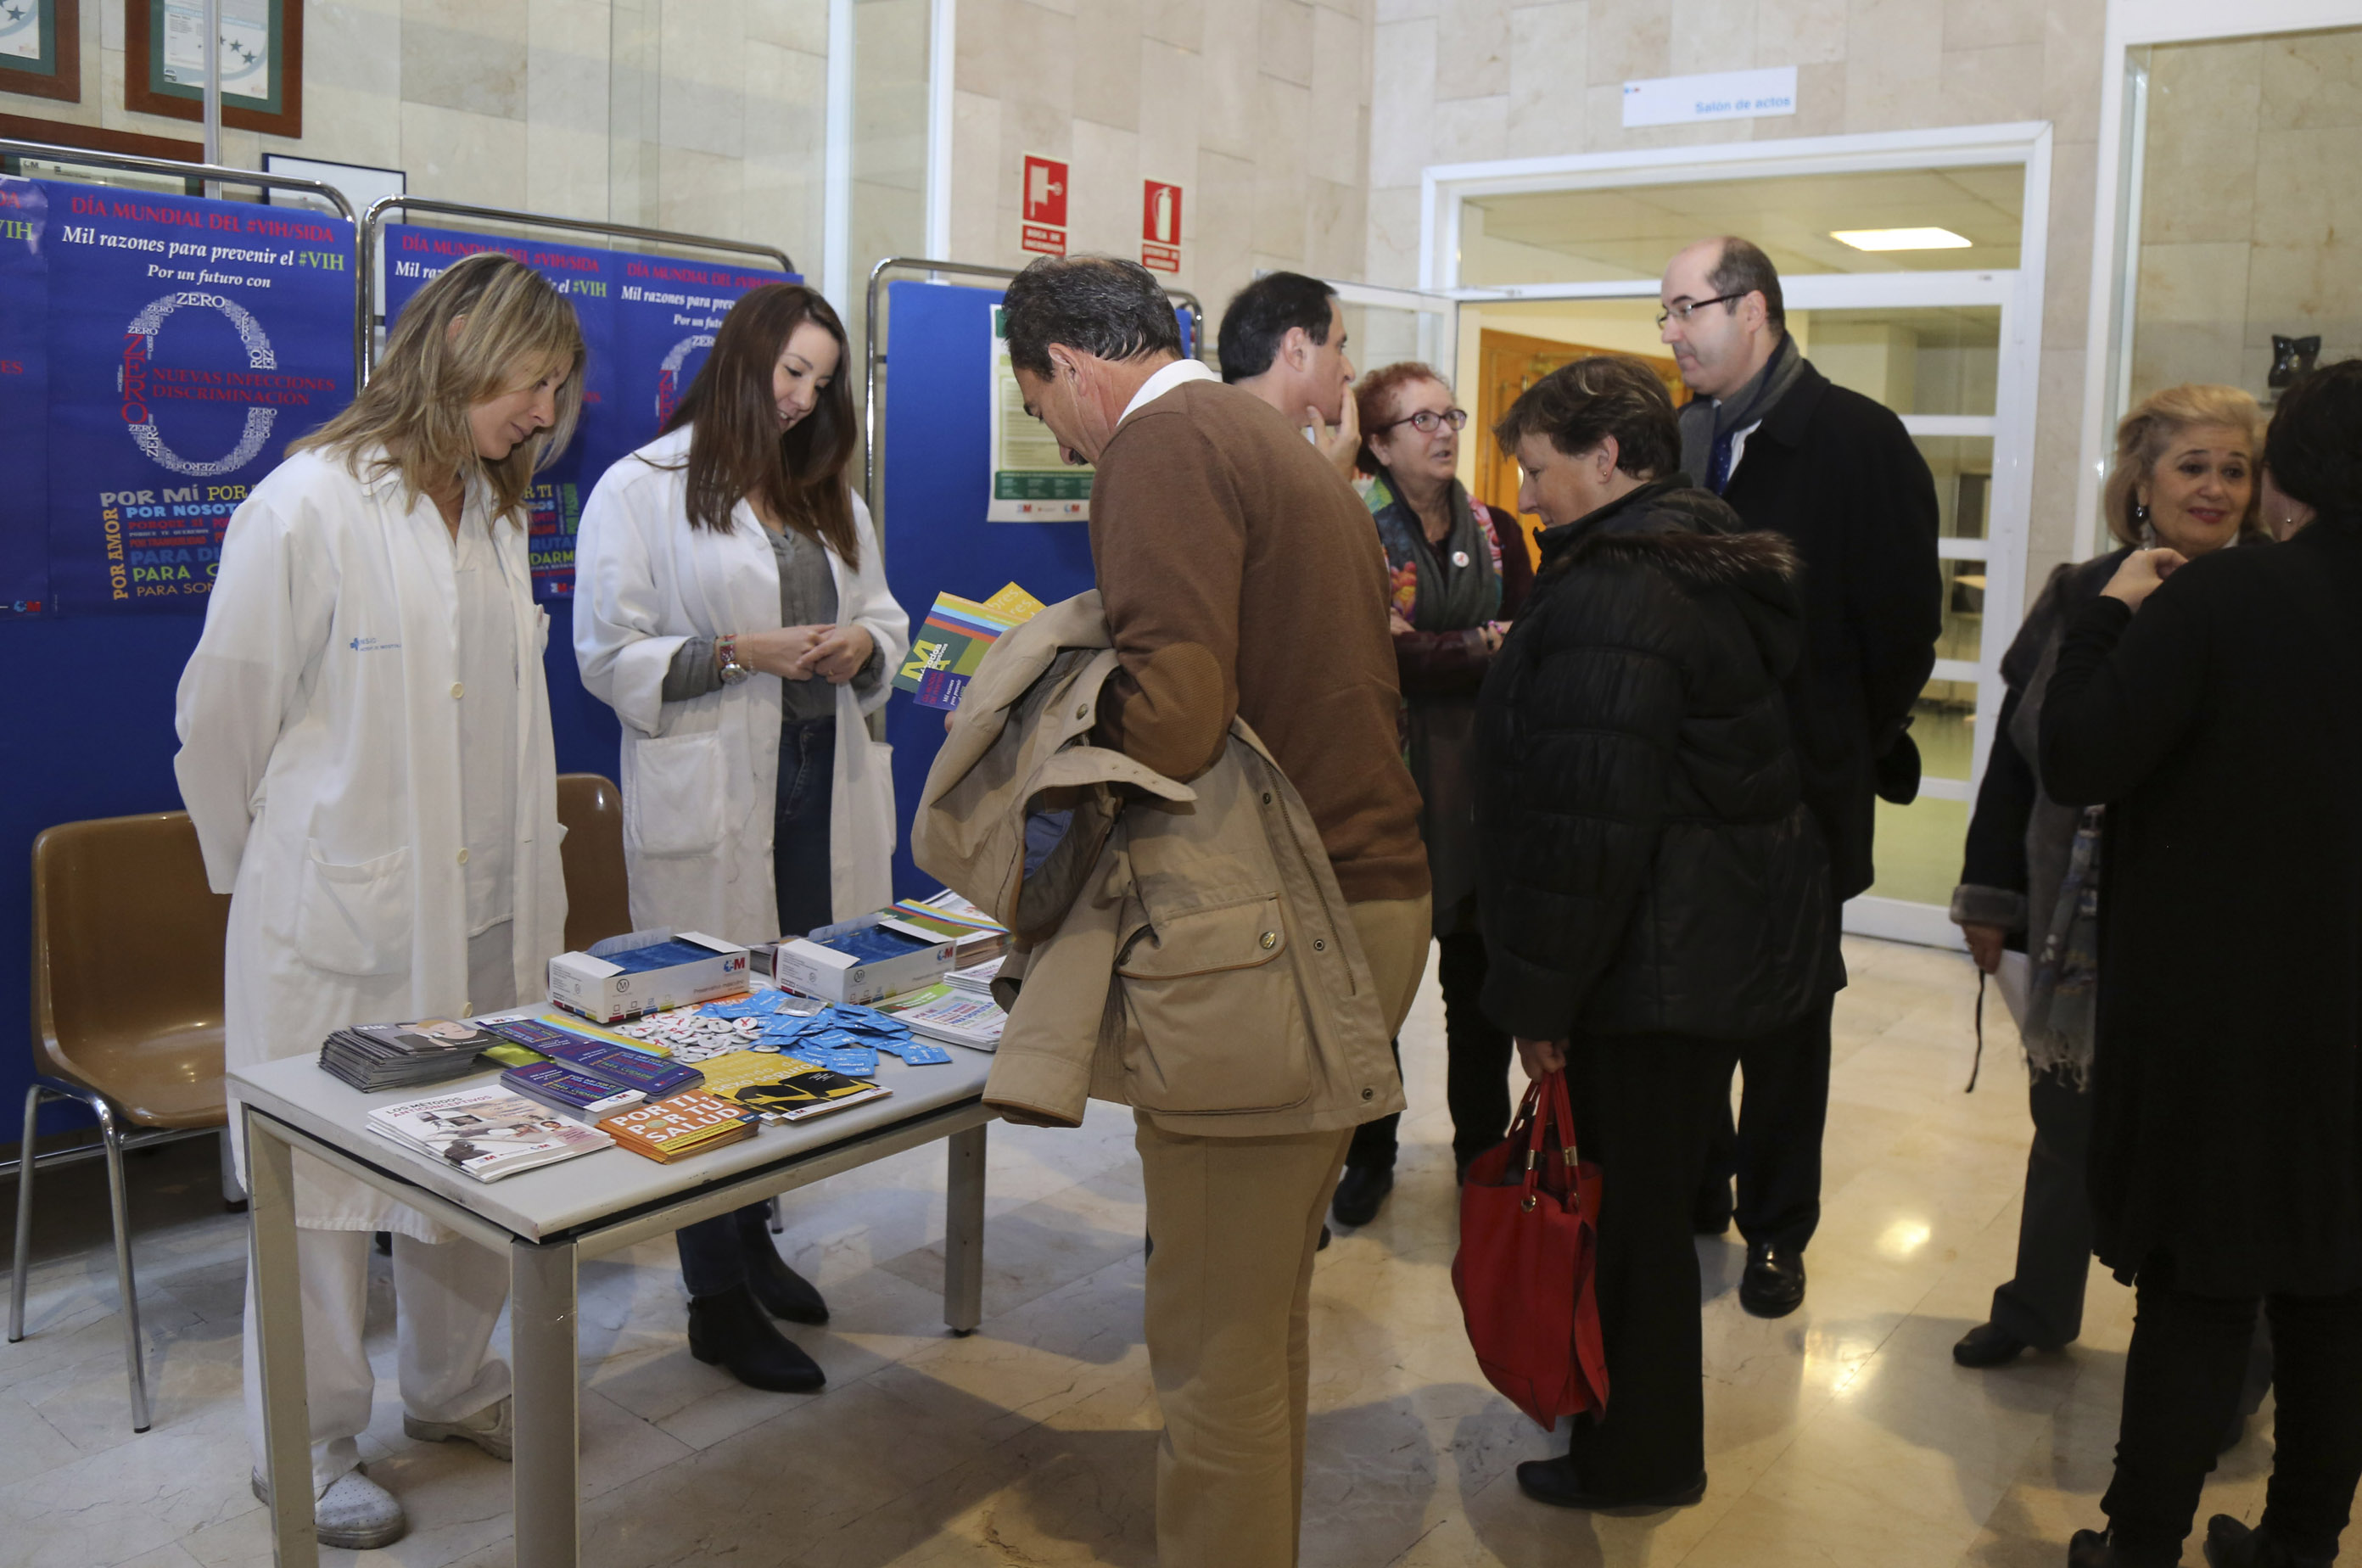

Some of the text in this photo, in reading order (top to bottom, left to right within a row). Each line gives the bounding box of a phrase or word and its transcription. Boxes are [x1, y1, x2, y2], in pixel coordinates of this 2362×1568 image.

[1695, 96, 1791, 114] Salón de actos
[71, 194, 334, 244] DÍA MUNDIAL DEL #VIH/SIDA
[62, 226, 344, 272] Mil razones para prevenir el #VIH
[401, 233, 429, 253] DÍA
[148, 264, 271, 288] Por un futuro con
[395, 260, 419, 279] Mil
[558, 279, 570, 294] el
[573, 280, 607, 298] #VIH
[627, 260, 650, 277] DÍA
[652, 266, 709, 285] MUNDIAL
[712, 271, 731, 288] DEL
[176, 292, 226, 309] ZERO
[621, 285, 642, 301] Mil
[643, 292, 686, 306] razones
[686, 295, 711, 310] para
[147, 304, 174, 314] ZERO
[127, 326, 159, 336] ZERO
[673, 314, 691, 326] Por
[691, 318, 704, 328] un
[121, 333, 148, 424] ZERO
[152, 368, 336, 391] NUEVAS INFECCIONES
[152, 384, 311, 406] DISCRIMINACIÓN
[249, 407, 278, 416] ZERO
[129, 423, 157, 432] ZERO
[99, 484, 248, 507] POR MÍ POR
[536, 484, 552, 499] TI
[126, 502, 240, 518] POR NOSOT
[103, 507, 129, 601] POR AMOR
[130, 548, 193, 566] PARA
[132, 565, 192, 583] PARA
[137, 585, 178, 597] PARA
[712, 1063, 814, 1093] sexo seguro
[386, 1096, 462, 1115] LOS MÉTODOS
[393, 1095, 493, 1117] ANTICONCEPTIVOS
[609, 1105, 670, 1127] POR
[645, 1108, 741, 1143] SALUD
